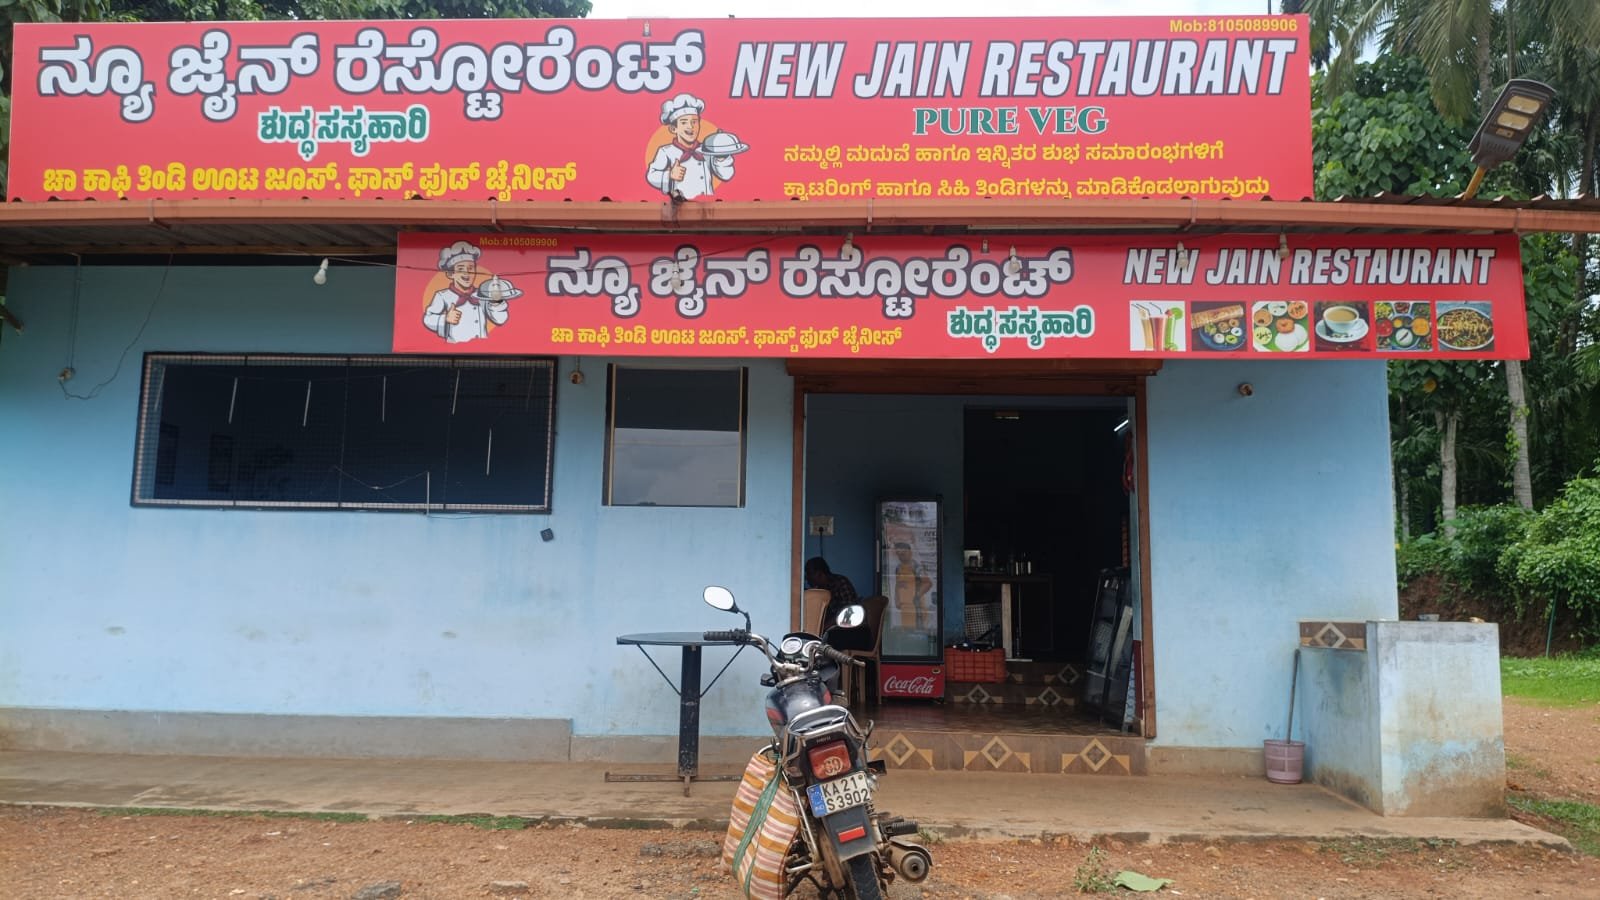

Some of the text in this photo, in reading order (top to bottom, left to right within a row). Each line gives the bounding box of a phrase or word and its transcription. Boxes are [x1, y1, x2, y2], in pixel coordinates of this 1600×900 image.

[1169, 18, 1298, 33] Mob:8105089906
[38, 25, 706, 122] ನ್ಯೂ ಜೈನ್ ರೆಸ್ಟೋರೆಂಟ್
[729, 38, 1297, 98] NEW JAIN RESTAURANT
[258, 106, 318, 161] ಶುದ್ಧ
[913, 106, 1109, 136] PURE VEG
[783, 140, 1224, 170] ನಮ್ಮಲ್ಲಿ ಮದುವೆ ಹಾಗೂ ಇನ್ನಿತರ ಶುಭ ಸಮಾರಂಭಗಳಿಗೆ
[83, 165, 132, 198] ಕಾಫಿ
[136, 162, 187, 191] ತಿಂಡಿ
[192, 166, 260, 191] ಊಟ
[876, 179, 932, 196] ಹಾಗೂ
[937, 179, 971, 196] ಸಿಹಿ
[546, 244, 1074, 320] ನ್ಯೂ ಜೈನ್ ರೆಸ್ಟೋರೆಂಟ್
[1122, 248, 1497, 286] NEW JAIN RESTAURANT
[578, 325, 610, 348] ಕಾಫಿ
[614, 325, 647, 344] ತಿಂಡಿ
[651, 329, 695, 345] ಊಟ
[947, 306, 1000, 353] ಶುದ್ಧ
[826, 788, 870, 811] S3902
